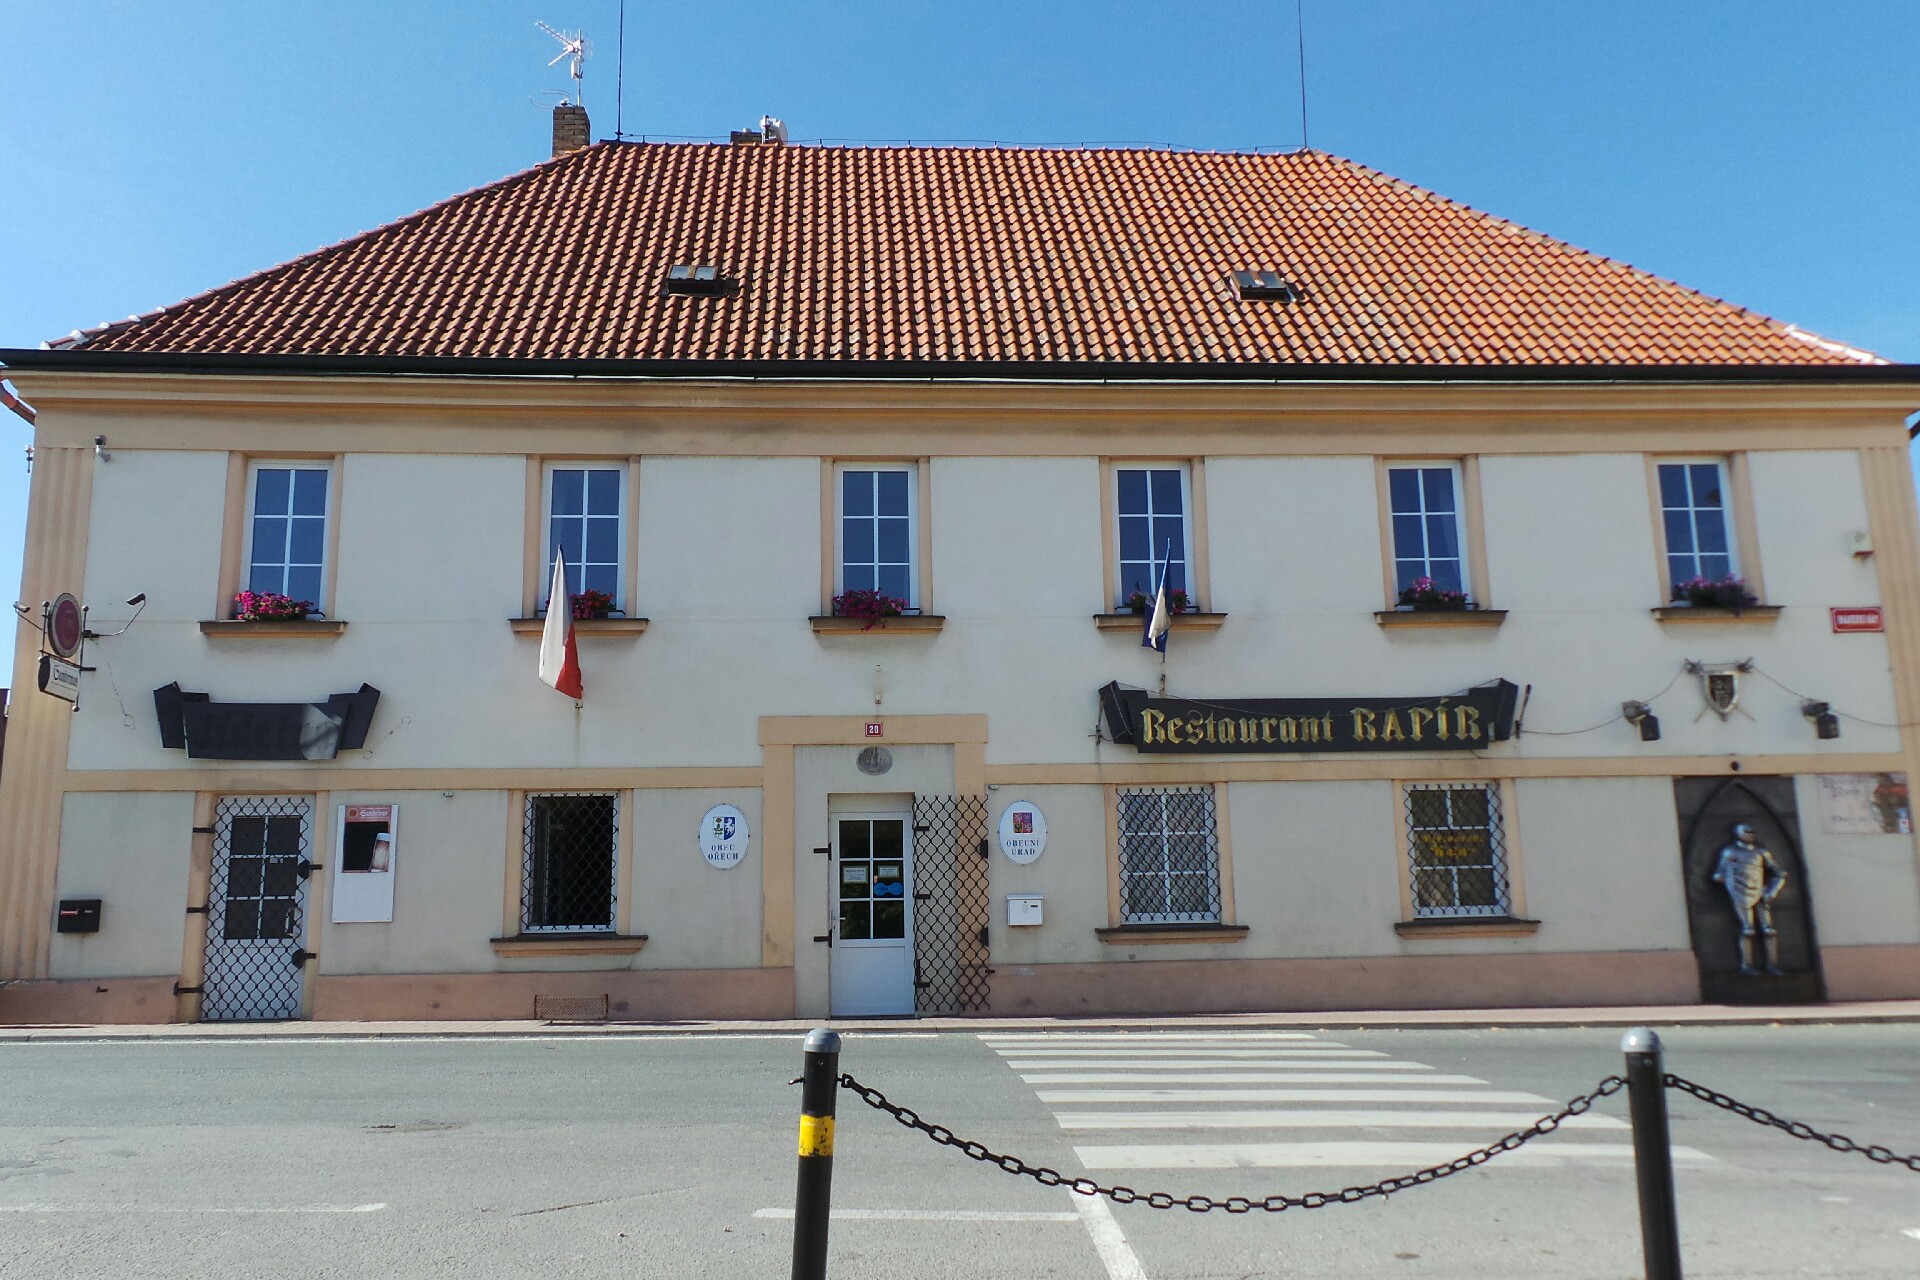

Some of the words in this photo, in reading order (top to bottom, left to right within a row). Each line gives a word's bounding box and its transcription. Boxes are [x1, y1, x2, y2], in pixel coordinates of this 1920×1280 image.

[1140, 707, 1334, 744] Restaurant
[1350, 698, 1482, 742] RAPÍR
[869, 725, 879, 734] 20
[708, 852, 739, 860] OŘECH
